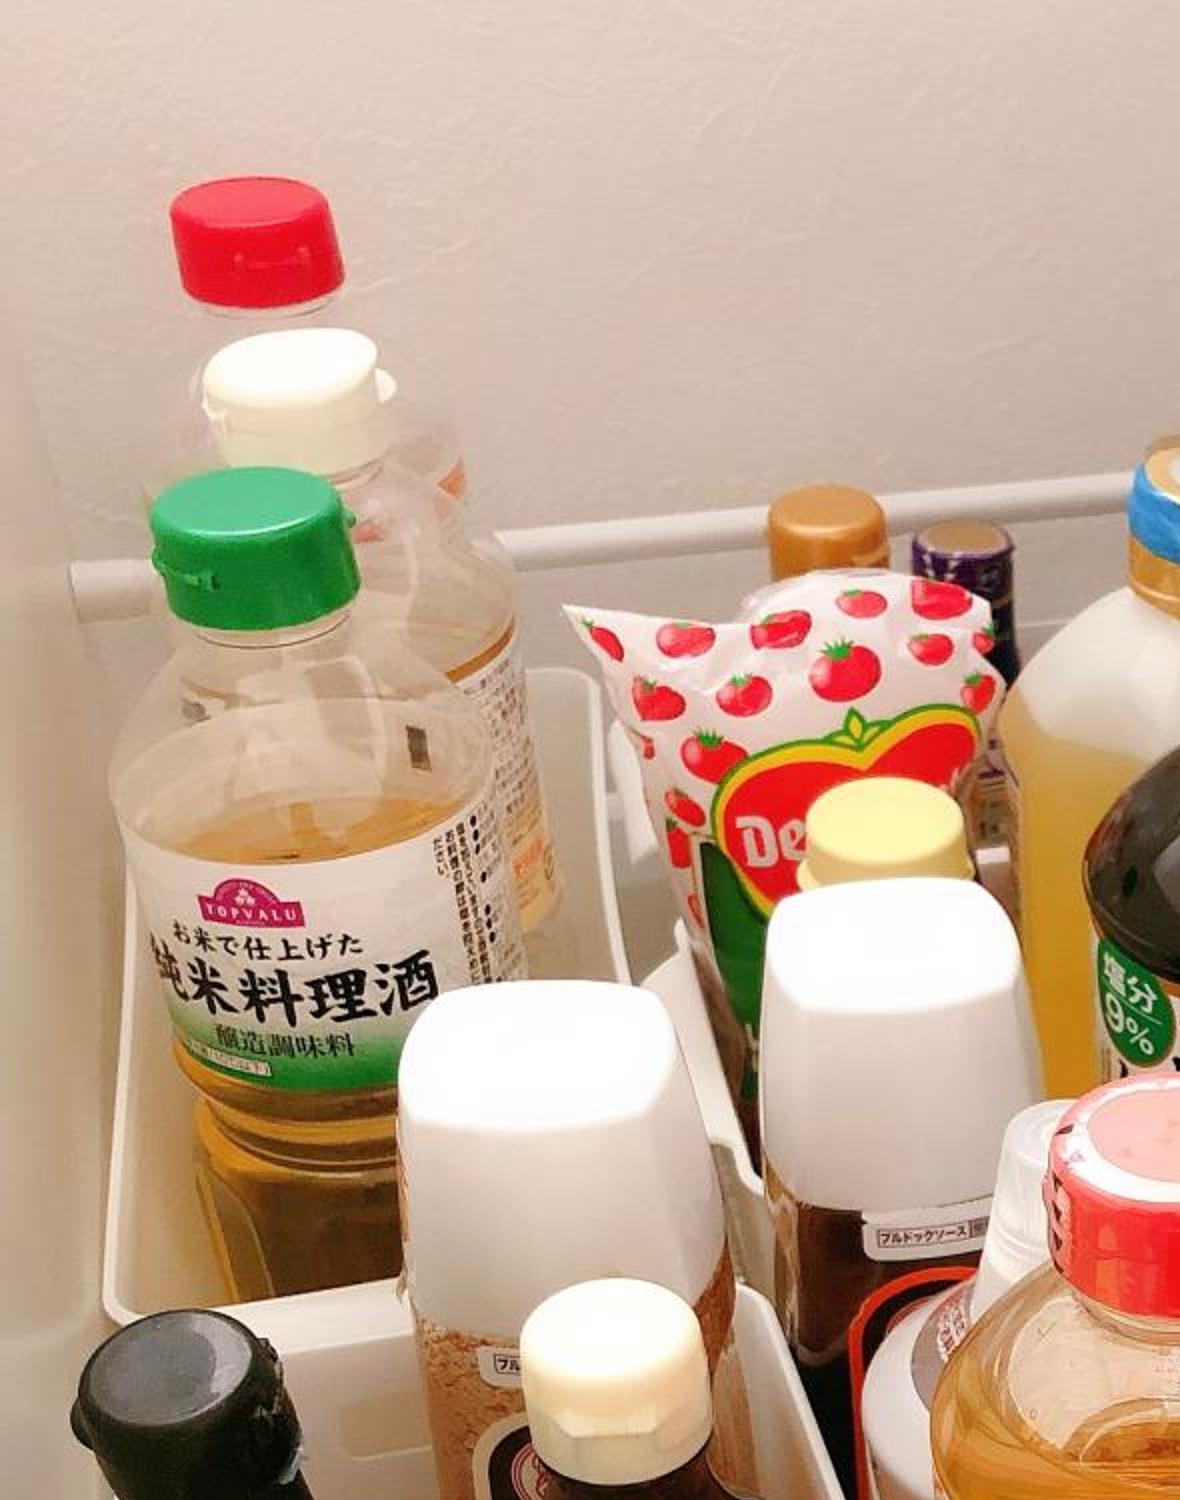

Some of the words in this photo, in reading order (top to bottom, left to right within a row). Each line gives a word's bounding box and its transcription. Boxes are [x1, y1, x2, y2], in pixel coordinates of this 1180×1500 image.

[735, 814, 807, 868] De
[172, 917, 365, 962] お米で仕上げた
[206, 900, 298, 923] TOPVALU
[149, 928, 440, 1028] 純米料理酒
[1102, 951, 1158, 1014] 塩分
[1104, 991, 1155, 1056] 9%
